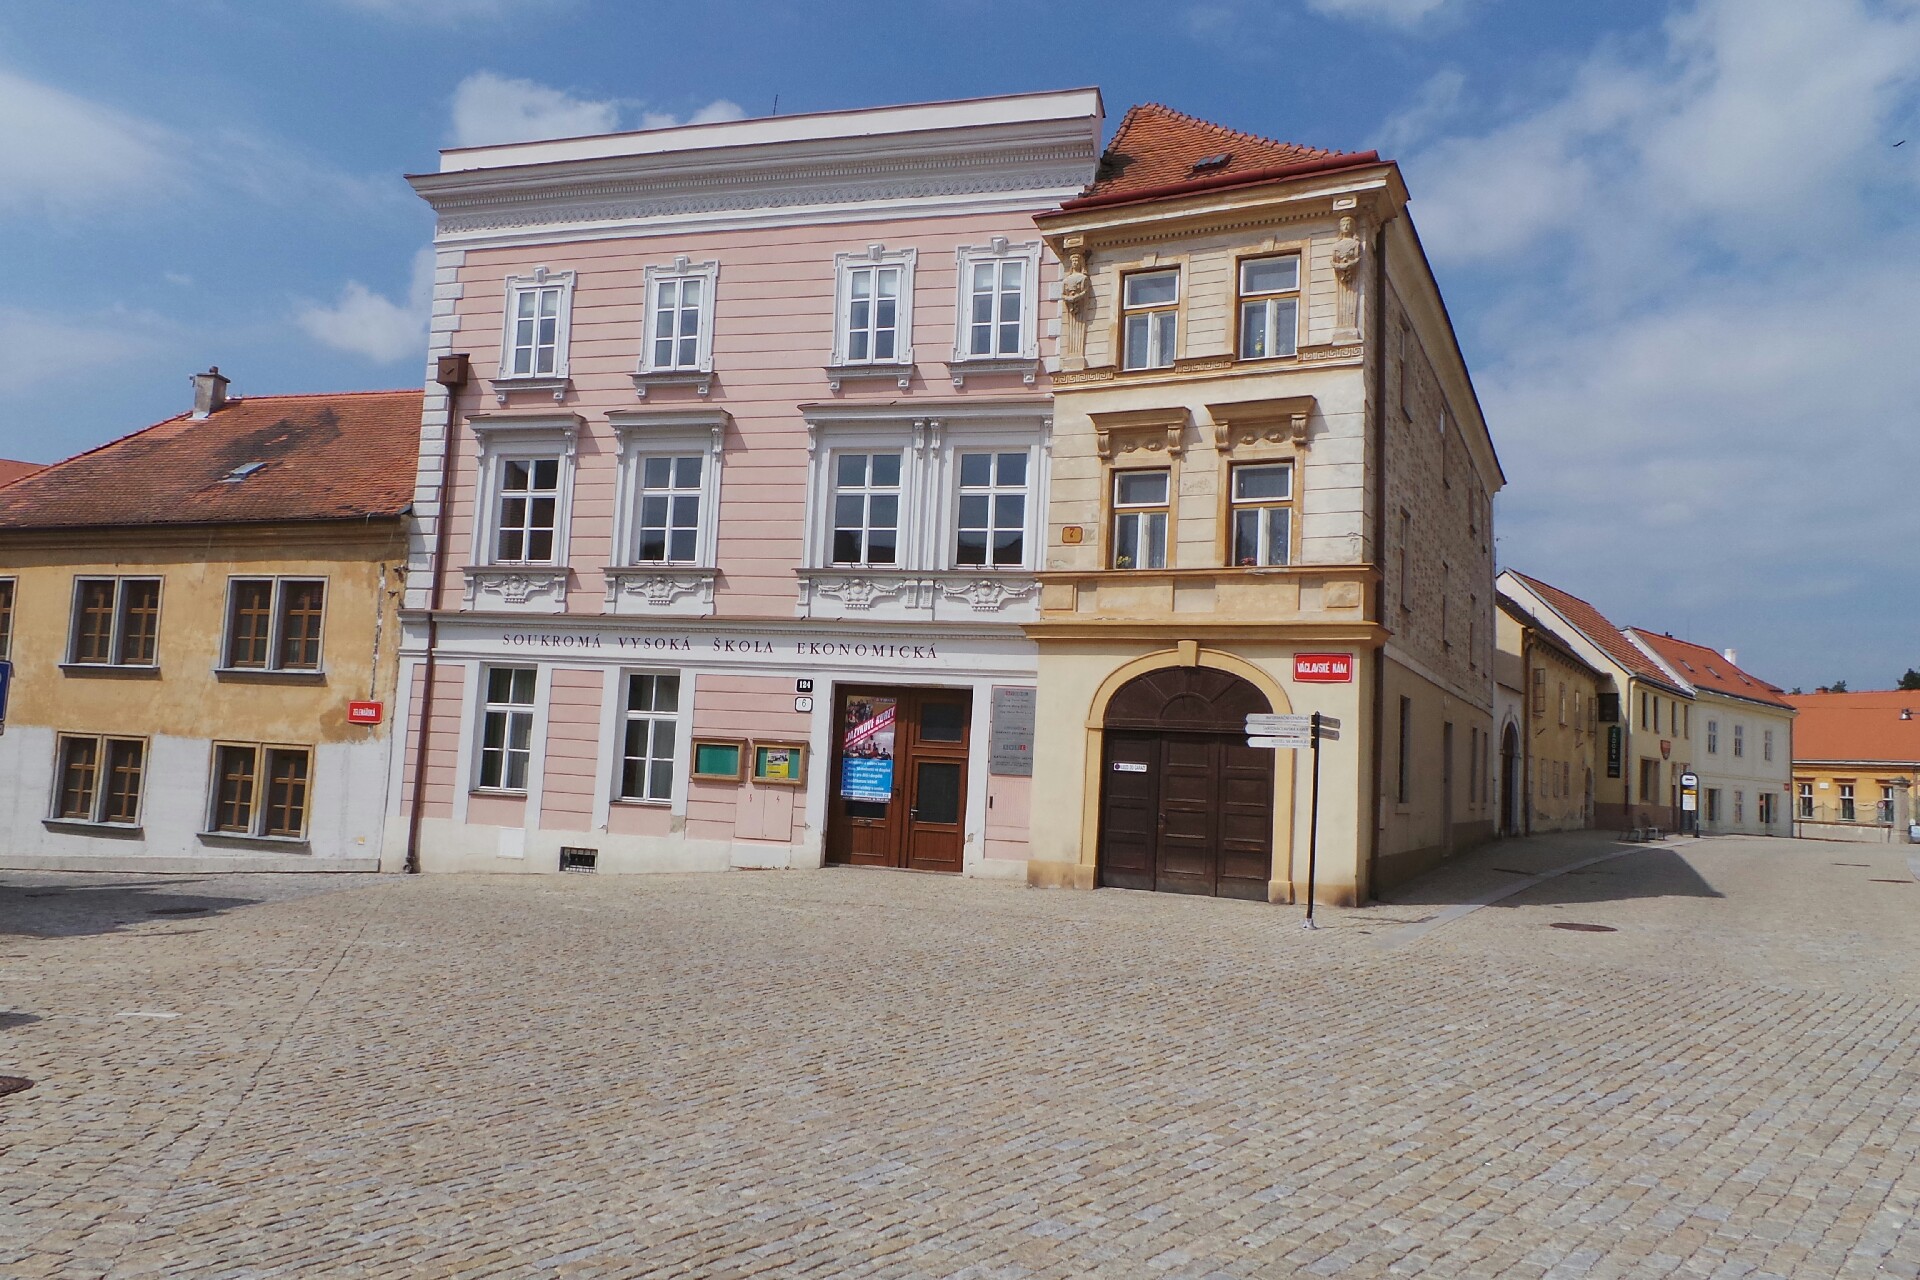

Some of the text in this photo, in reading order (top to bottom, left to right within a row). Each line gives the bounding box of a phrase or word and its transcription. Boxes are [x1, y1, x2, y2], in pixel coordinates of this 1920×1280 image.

[1069, 528, 1076, 538] 7
[502, 633, 937, 659] SOUKROMÁ VYSOKÁ ŠKOLA EKONOMICKÁ
[1297, 661, 1330, 673] VÁCLAVSKÉ
[799, 680, 811, 689] 124
[801, 698, 807, 708] 6
